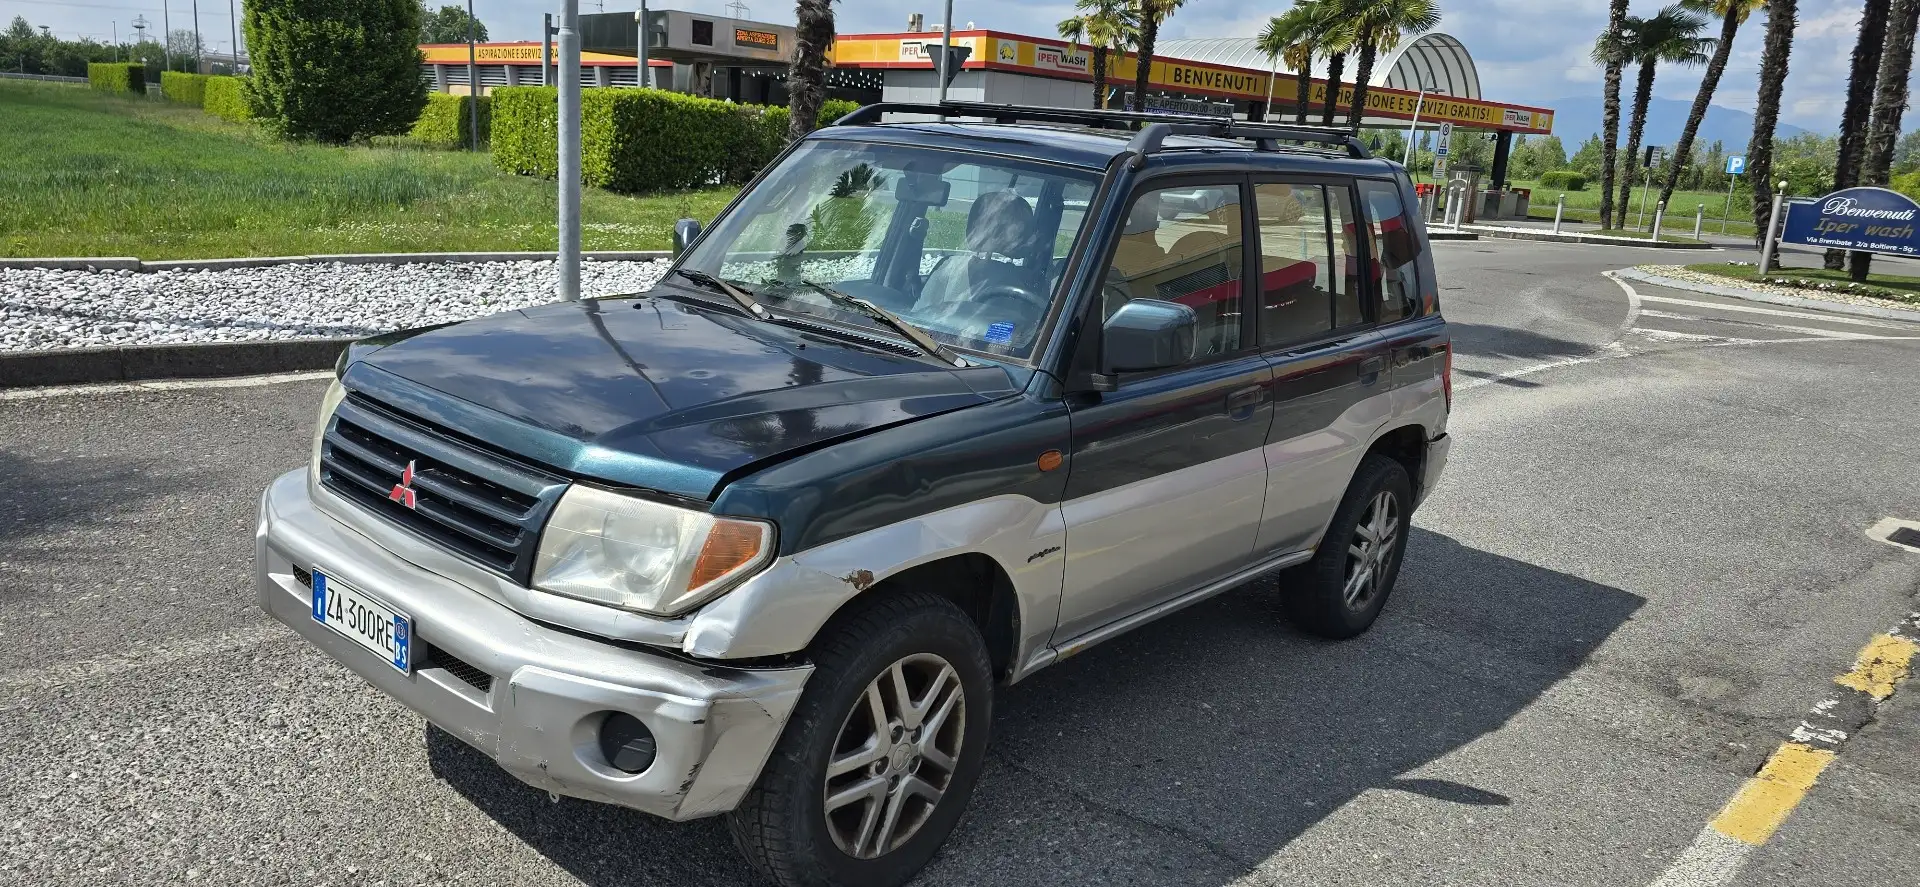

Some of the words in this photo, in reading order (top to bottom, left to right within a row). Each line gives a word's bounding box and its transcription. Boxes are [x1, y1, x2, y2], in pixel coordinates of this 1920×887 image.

[478, 48, 515, 59] ASPIRAZIONE
[515, 49, 520, 58] E
[521, 48, 543, 59] SERVIZ
[902, 47, 918, 55] IPER
[1038, 52, 1058, 64] IPER
[1060, 56, 1086, 67] WASH
[1173, 67, 1257, 92] BENVENUTI
[1159, 99, 1189, 112] APERTO
[1315, 86, 1395, 110] AIRIONE
[1398, 99, 1404, 111] E
[1450, 104, 1490, 121] GRATIS!
[1730, 157, 1743, 172] P
[1822, 197, 1916, 221] Benvenuti
[1813, 218, 1859, 236] Iper
[1864, 224, 1914, 239] wash
[1818, 238, 1853, 247] Brembate
[327, 586, 343, 624] ZA
[348, 598, 394, 653] 300RE
[395, 641, 407, 664] BS
